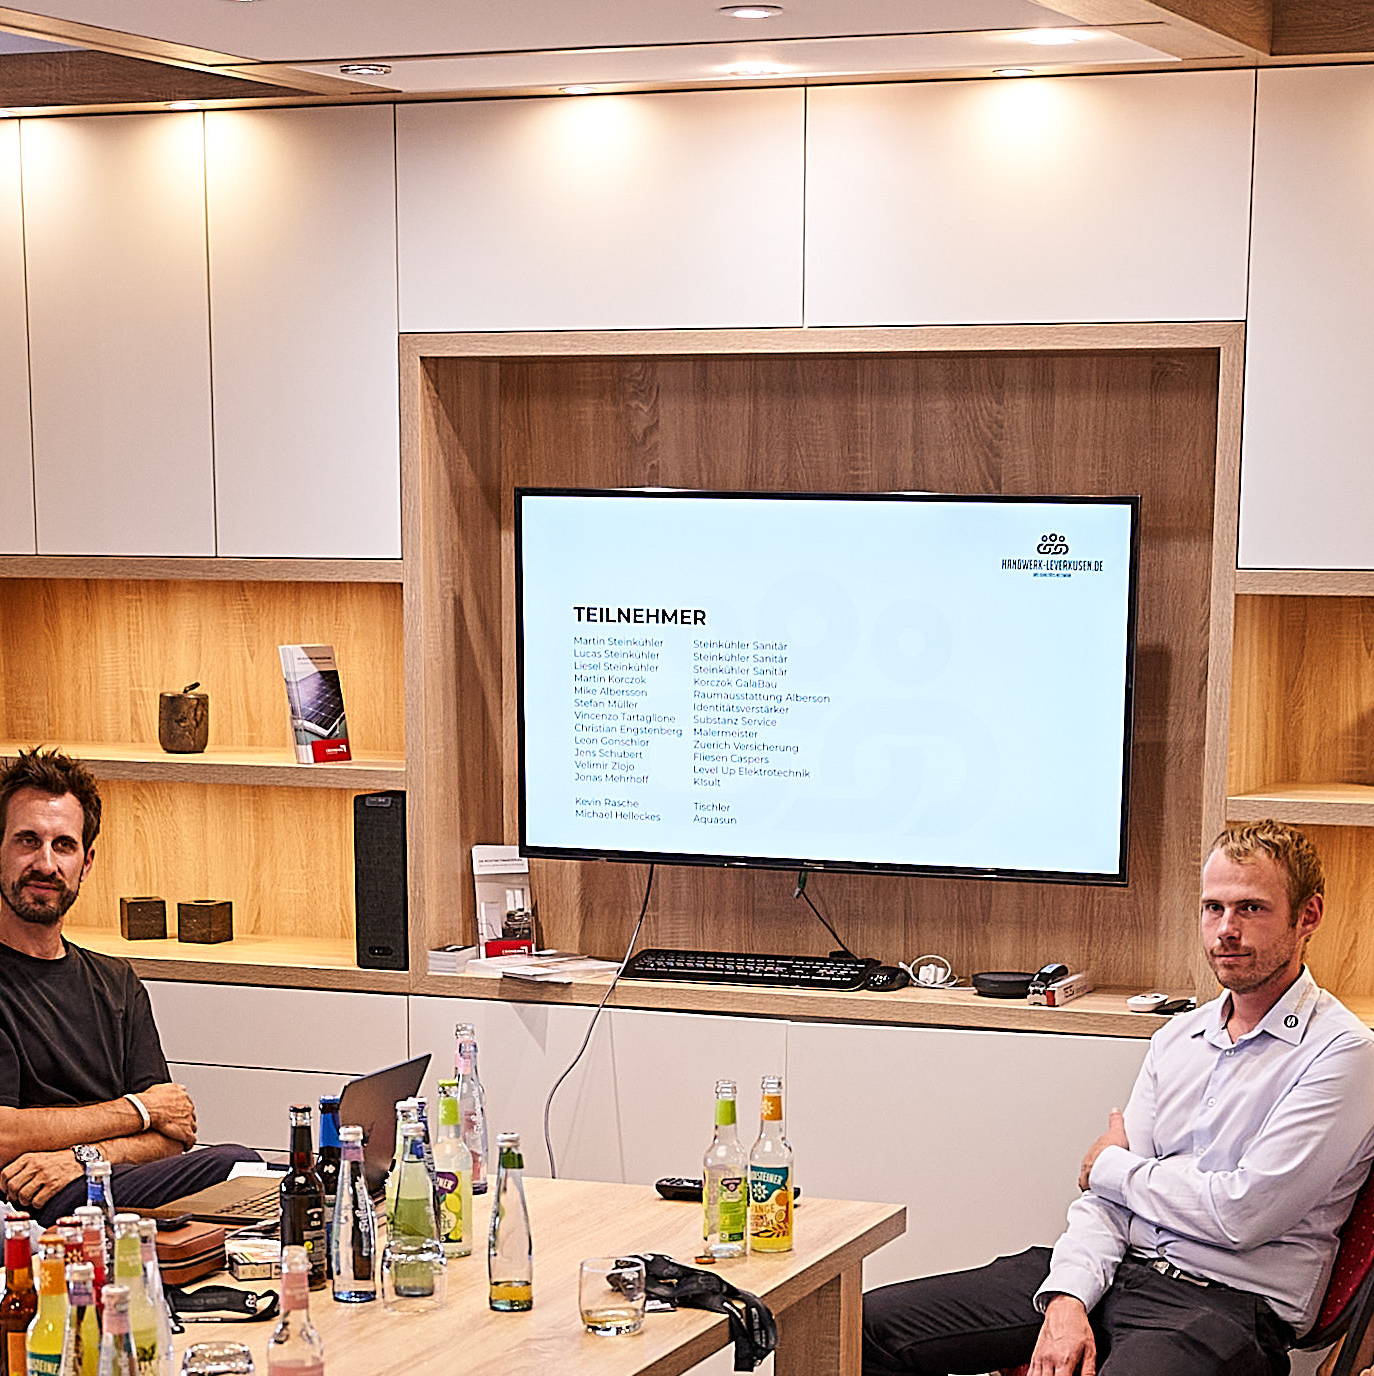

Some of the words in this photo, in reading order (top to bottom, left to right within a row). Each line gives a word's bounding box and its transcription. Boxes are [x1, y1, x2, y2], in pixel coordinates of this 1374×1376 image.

[573, 607, 706, 625] TEILNEHMER
[574, 637, 605, 645] Martin
[608, 637, 663, 647] Steinkühler
[694, 640, 749, 649] Steinkühler
[753, 641, 787, 650] Sanitär
[574, 649, 601, 658] Lucas
[604, 650, 659, 659] Steinkühler
[694, 653, 749, 662] Steinkühler
[753, 654, 787, 663] Sanitär
[574, 662, 600, 670] Liesel
[604, 662, 658, 672] Steinkühler
[694, 665, 749, 675] Steinkühler
[753, 666, 787, 676] Sanitär
[574, 674, 605, 683] Martin
[608, 675, 646, 684] Korczok
[694, 678, 732, 687] Korczok
[736, 679, 777, 689] GalaBau
[574, 686, 597, 695] Mike
[694, 691, 782, 703] Raumausstattung
[786, 693, 830, 703] Alberson
[574, 699, 604, 708] Stefan
[608, 700, 638, 708] Müller
[694, 703, 789, 714] Identitätsverstärker
[574, 711, 618, 720] Vincenzo
[621, 713, 676, 724] Tartaglione
[694, 716, 738, 725] Substanz
[741, 717, 777, 726] Service
[574, 724, 617, 733] Christian
[620, 725, 683, 737] Engstenberg
[694, 728, 758, 738] Malermeister
[574, 736, 597, 745] Leon
[694, 740, 730, 750] Zuerich
[734, 742, 798, 754] Versicherung
[574, 748, 596, 757] Jens
[599, 749, 643, 759] Schubert
[694, 753, 727, 762] Fliesen
[731, 754, 769, 764] Caspers
[574, 760, 608, 769] Velimir
[694, 766, 718, 774] Level
[722, 767, 735, 776] Up
[739, 767, 810, 778] Elektrotechnik
[575, 773, 602, 781] Jonas
[605, 774, 649, 784] Mehrhoff
[576, 797, 601, 806] Kevin
[604, 798, 639, 808] Rasche
[694, 802, 730, 812] Tischler
[576, 810, 612, 818] Michael
[616, 811, 661, 821] Helleckes
[693, 815, 737, 825] Aquasun
